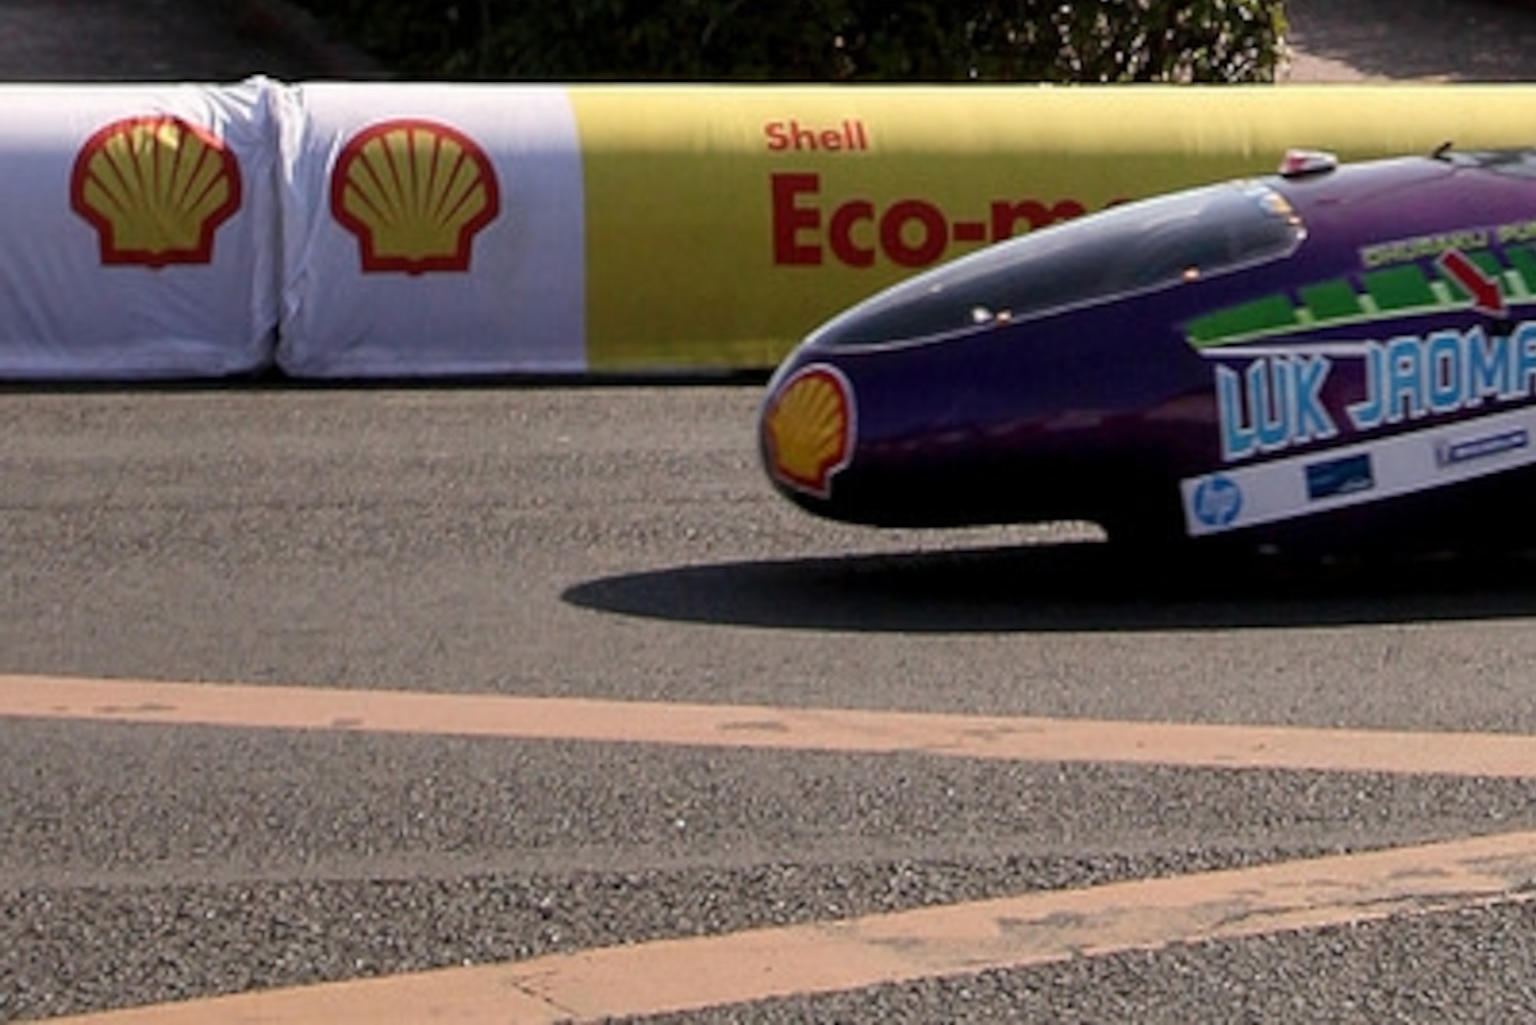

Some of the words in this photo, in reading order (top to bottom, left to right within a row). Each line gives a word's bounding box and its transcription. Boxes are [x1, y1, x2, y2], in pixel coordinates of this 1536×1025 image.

[764, 120, 868, 152] Shell
[771, 173, 1131, 267] Eco-m
[1216, 354, 1339, 462] LUK
